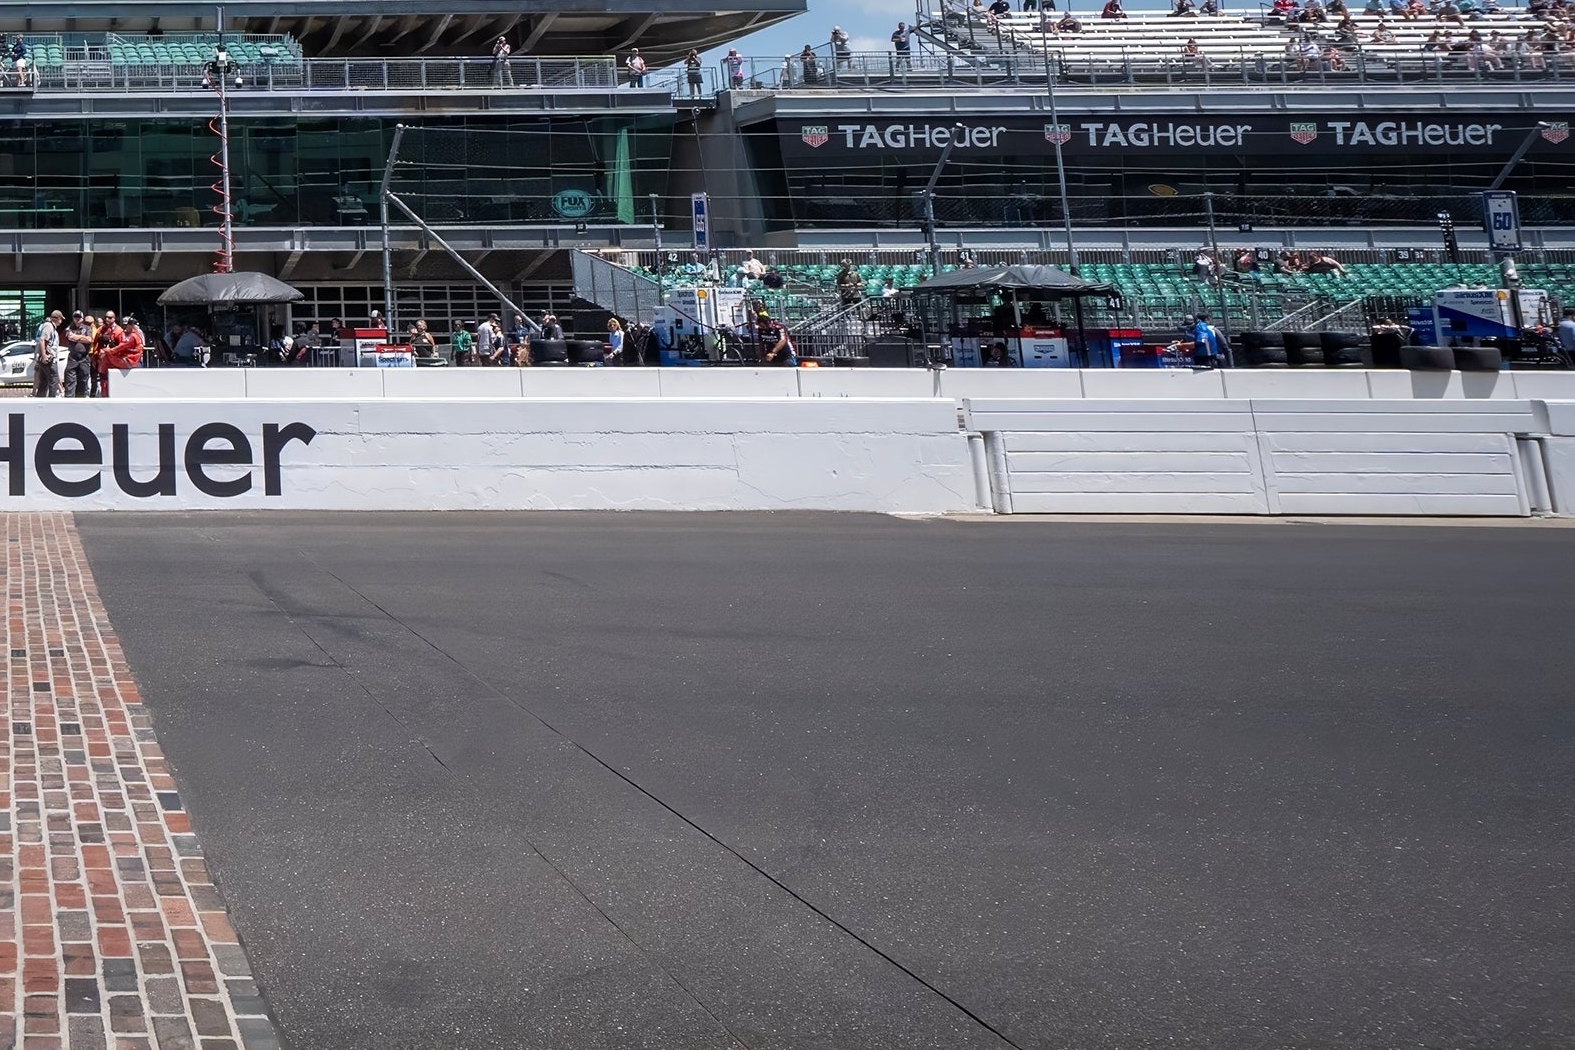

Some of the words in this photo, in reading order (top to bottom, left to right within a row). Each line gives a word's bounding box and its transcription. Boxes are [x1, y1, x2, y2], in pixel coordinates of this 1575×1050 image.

[561, 196, 587, 207] FOX
[668, 252, 679, 262] 42
[1258, 251, 1268, 260] 40
[1398, 251, 1409, 260] 39
[1109, 297, 1121, 308] 41
